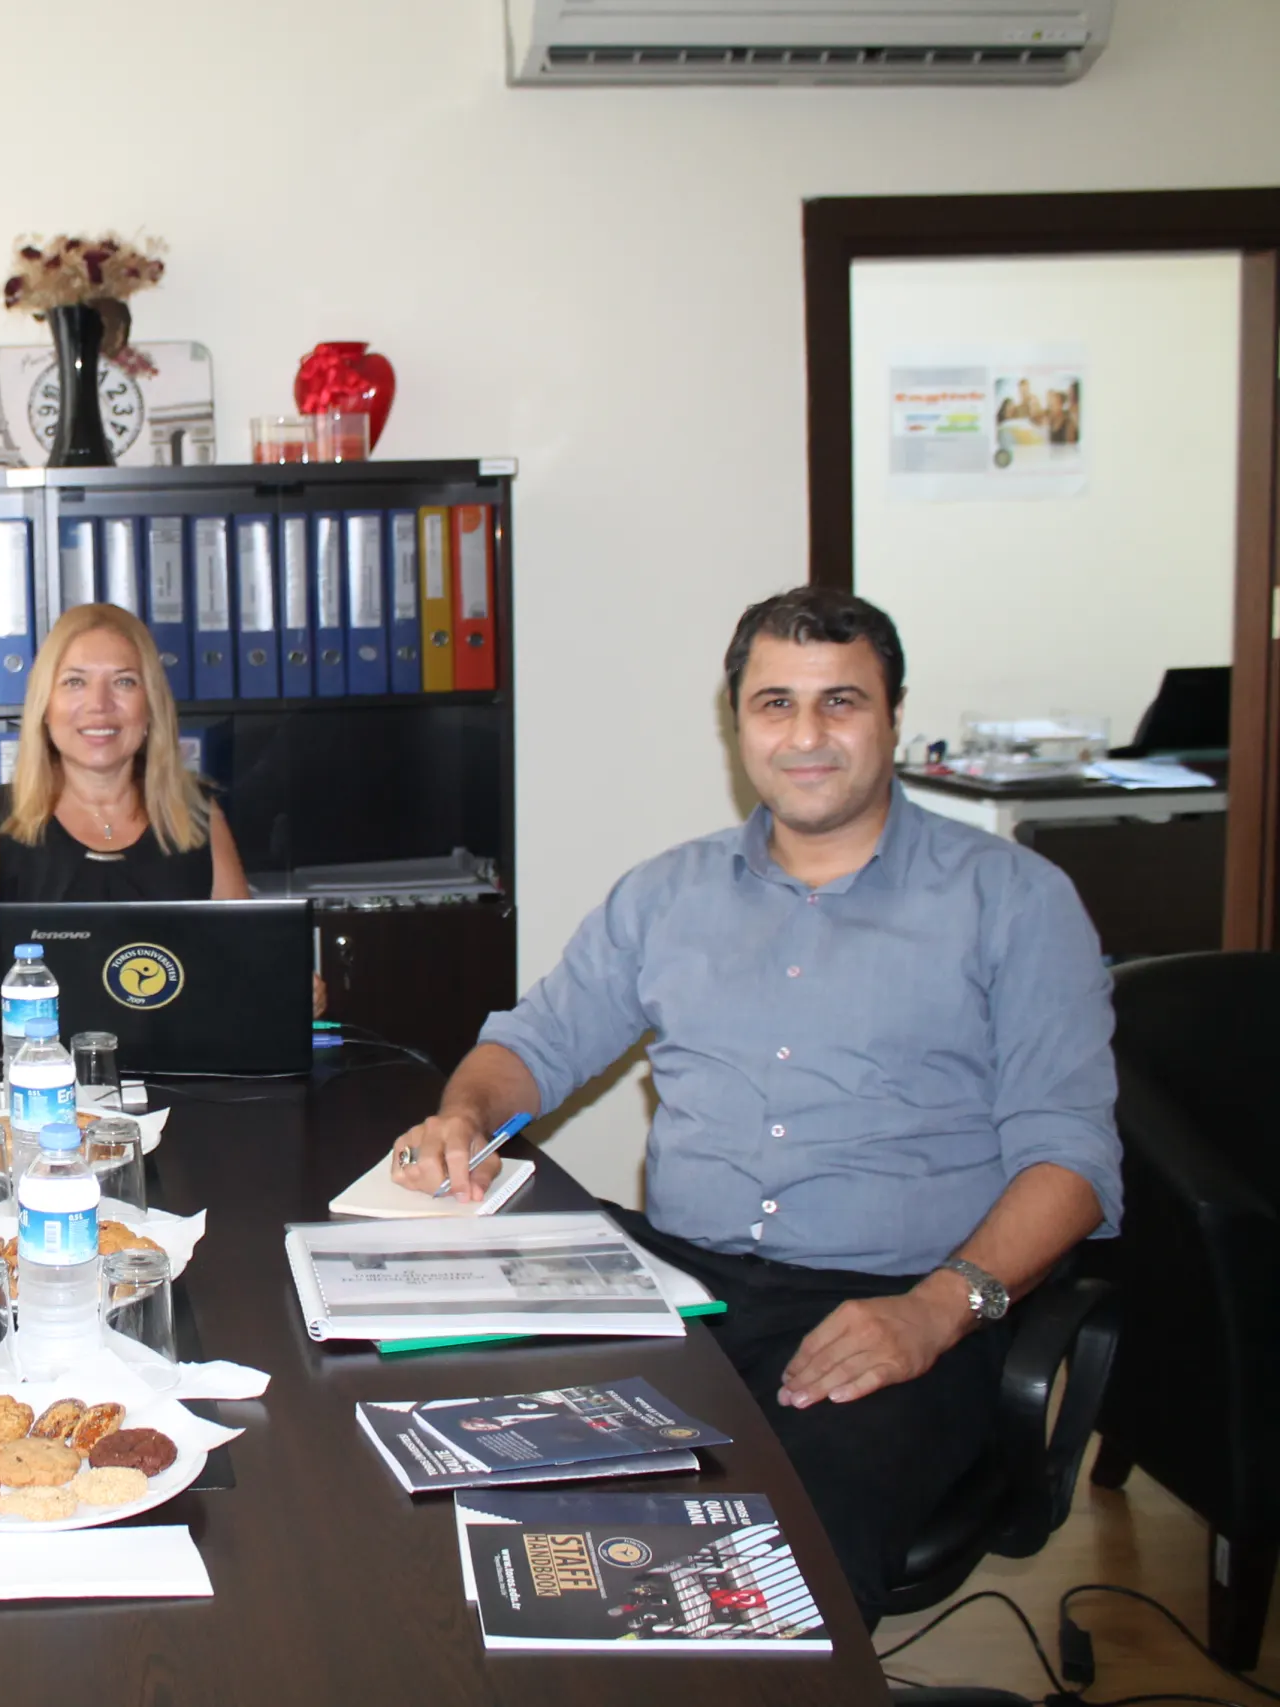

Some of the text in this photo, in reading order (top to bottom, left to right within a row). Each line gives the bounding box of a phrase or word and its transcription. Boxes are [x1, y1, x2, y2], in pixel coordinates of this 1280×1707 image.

[106, 383, 128, 401] 2
[112, 404, 133, 416] 3
[109, 421, 128, 437] 4
[31, 929, 91, 940] lenovo
[111, 949, 136, 968] TOROS
[702, 1501, 726, 1524] QUAL
[733, 1500, 749, 1517] TOROS
[526, 1534, 560, 1597] HANDBOOK
[550, 1536, 593, 1587] STAFF
[501, 1548, 521, 1611] www.toros.edu.tr
